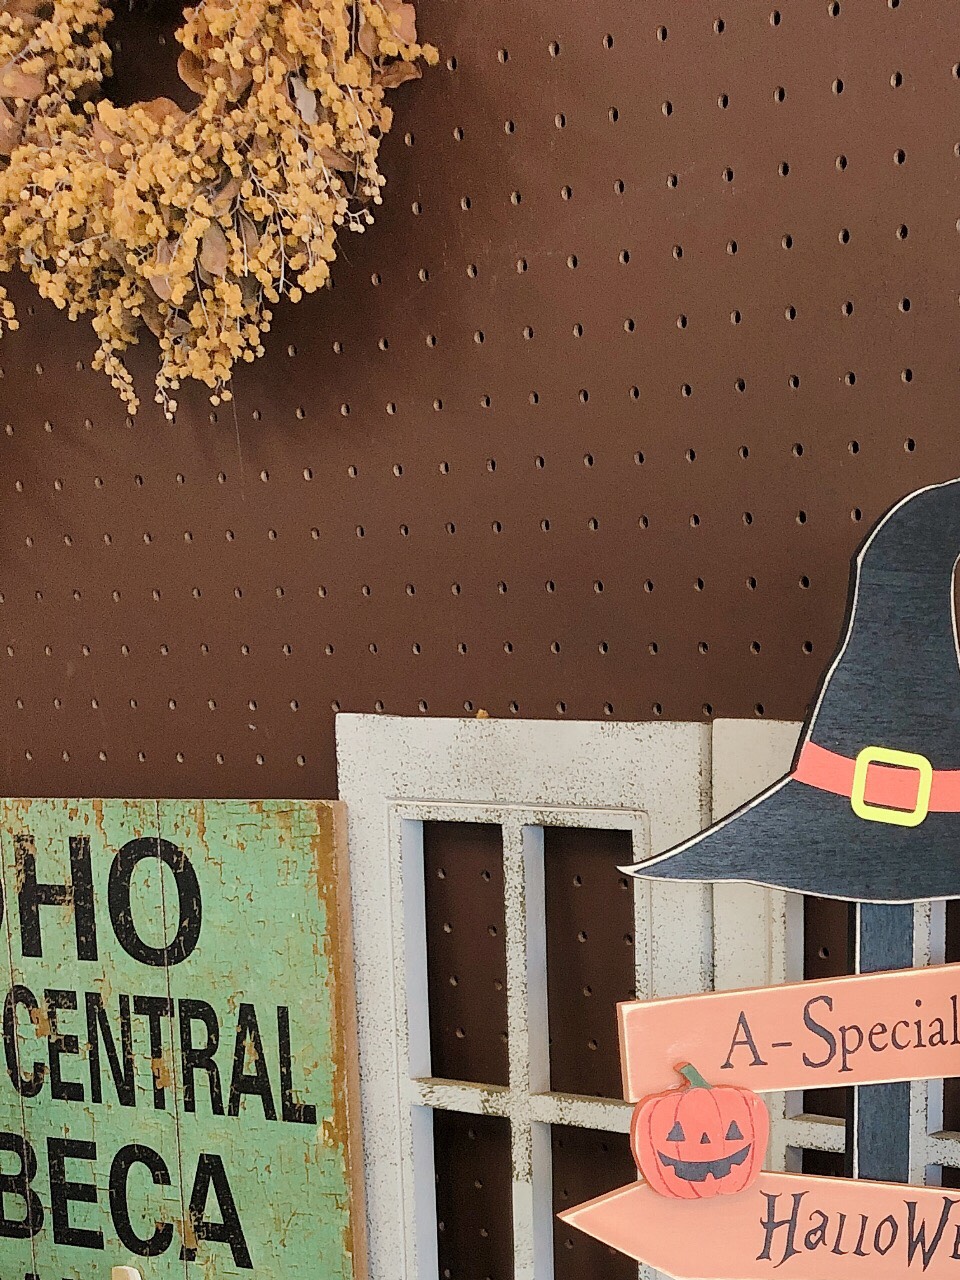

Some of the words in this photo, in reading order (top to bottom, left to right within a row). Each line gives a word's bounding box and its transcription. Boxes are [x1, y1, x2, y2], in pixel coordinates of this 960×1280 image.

[0, 835, 203, 967] HO
[5, 984, 318, 1126] CENTRAL
[0, 1131, 255, 1270] BECA
